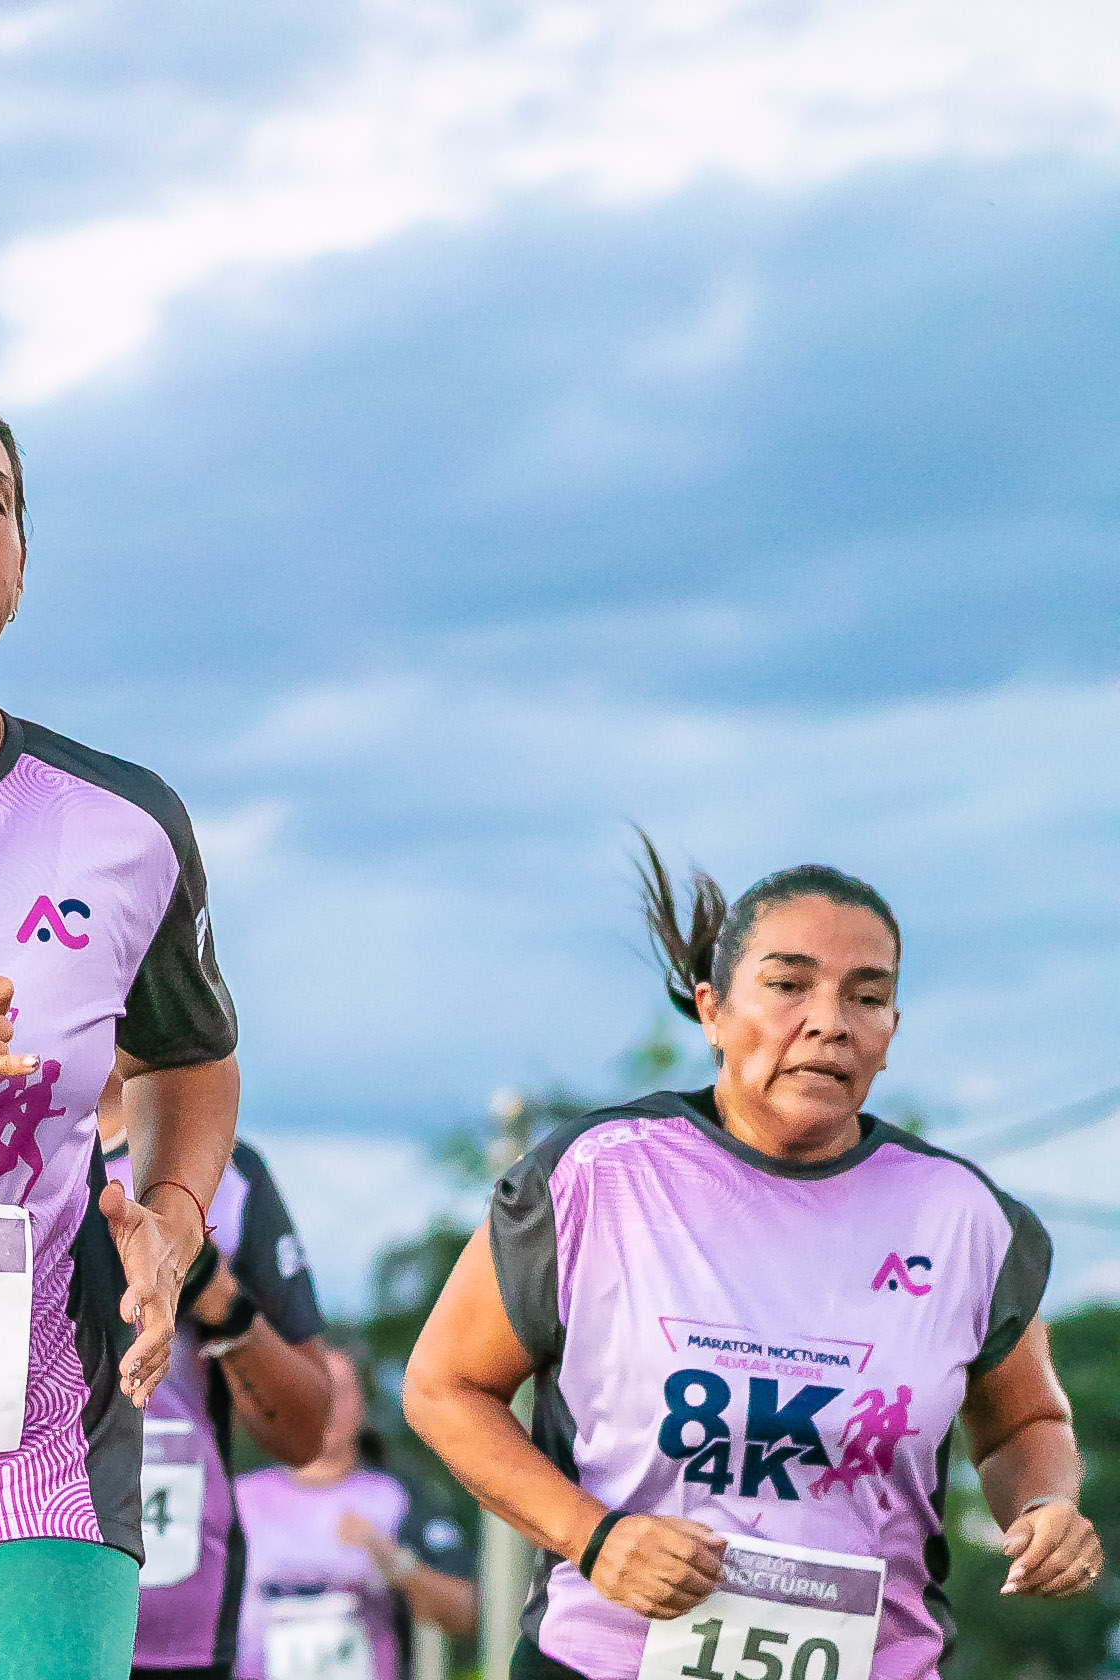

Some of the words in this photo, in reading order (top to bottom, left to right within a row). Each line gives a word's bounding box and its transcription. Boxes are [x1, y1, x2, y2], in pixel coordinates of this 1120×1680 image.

[687, 1334, 763, 1356] MARATON
[767, 1346, 851, 1368] NOCTURNA
[658, 1369, 845, 1467] 8K
[684, 1440, 801, 1500] 4K
[722, 1564, 840, 1601] NOCTURNA
